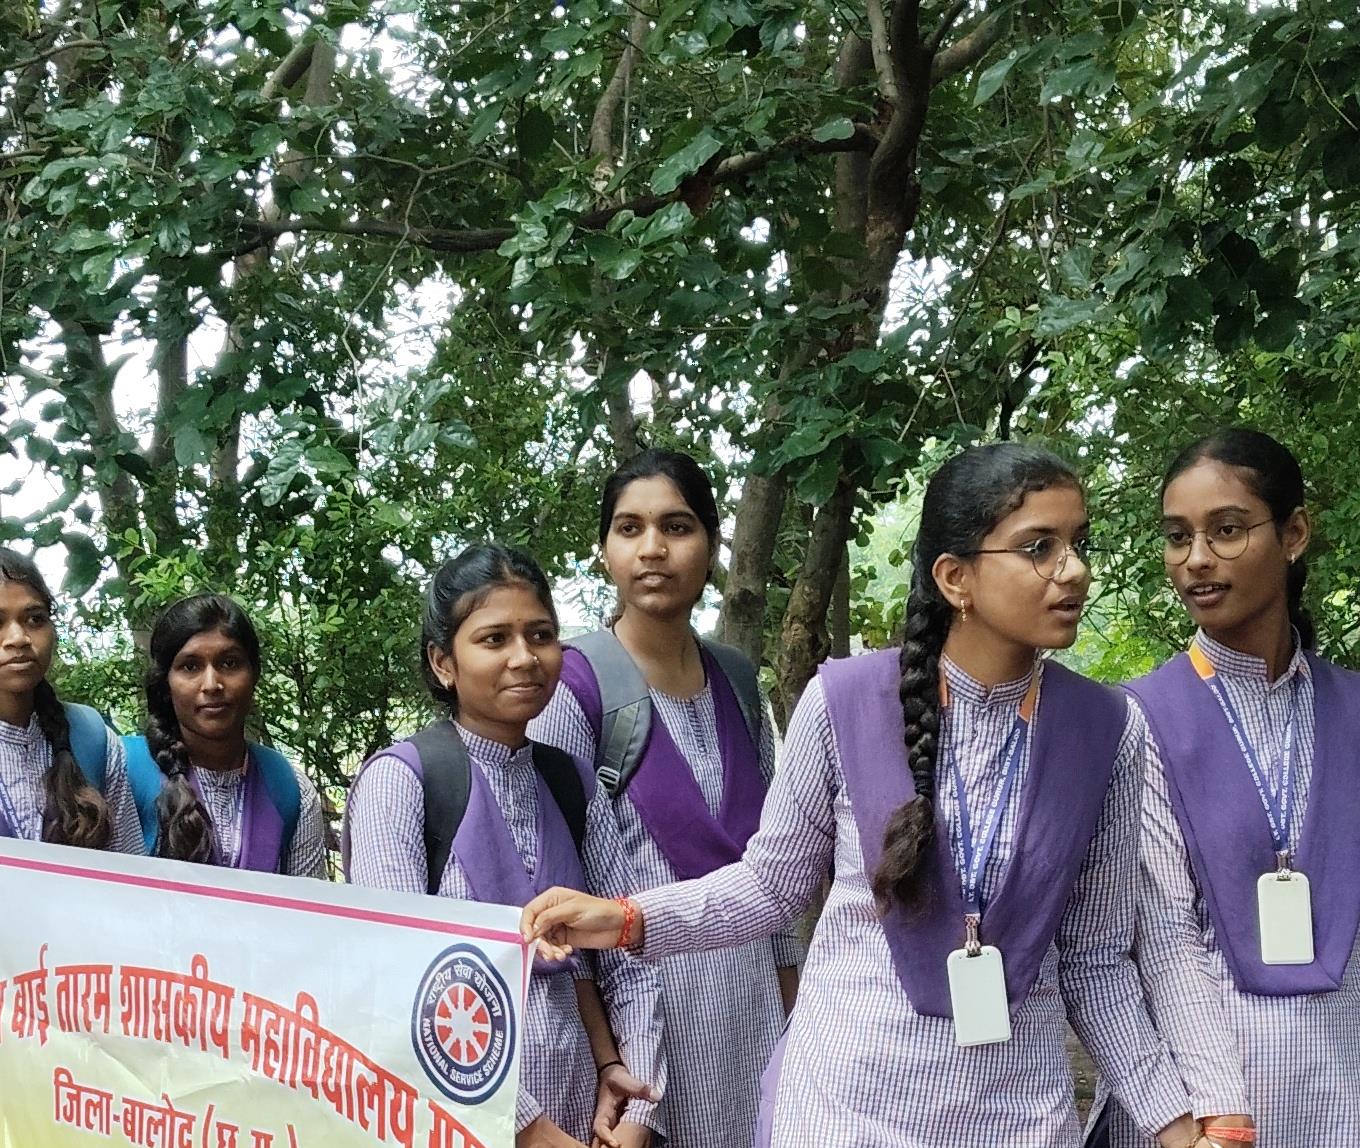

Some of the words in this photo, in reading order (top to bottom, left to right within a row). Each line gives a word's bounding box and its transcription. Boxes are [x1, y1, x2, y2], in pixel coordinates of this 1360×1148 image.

[953, 800, 962, 838] COLLEGE
[979, 808, 995, 844] COLLEGE
[11, 943, 48, 1047] बाई
[55, 964, 113, 1033] तारम
[120, 954, 235, 1059] शासकीय
[453, 959, 473, 980] सेवा
[474, 971, 502, 1017] योजना
[422, 1018, 449, 1076] NATIONAL
[450, 1067, 483, 1086] SERVICE
[484, 1030, 504, 1076] SCHEME
